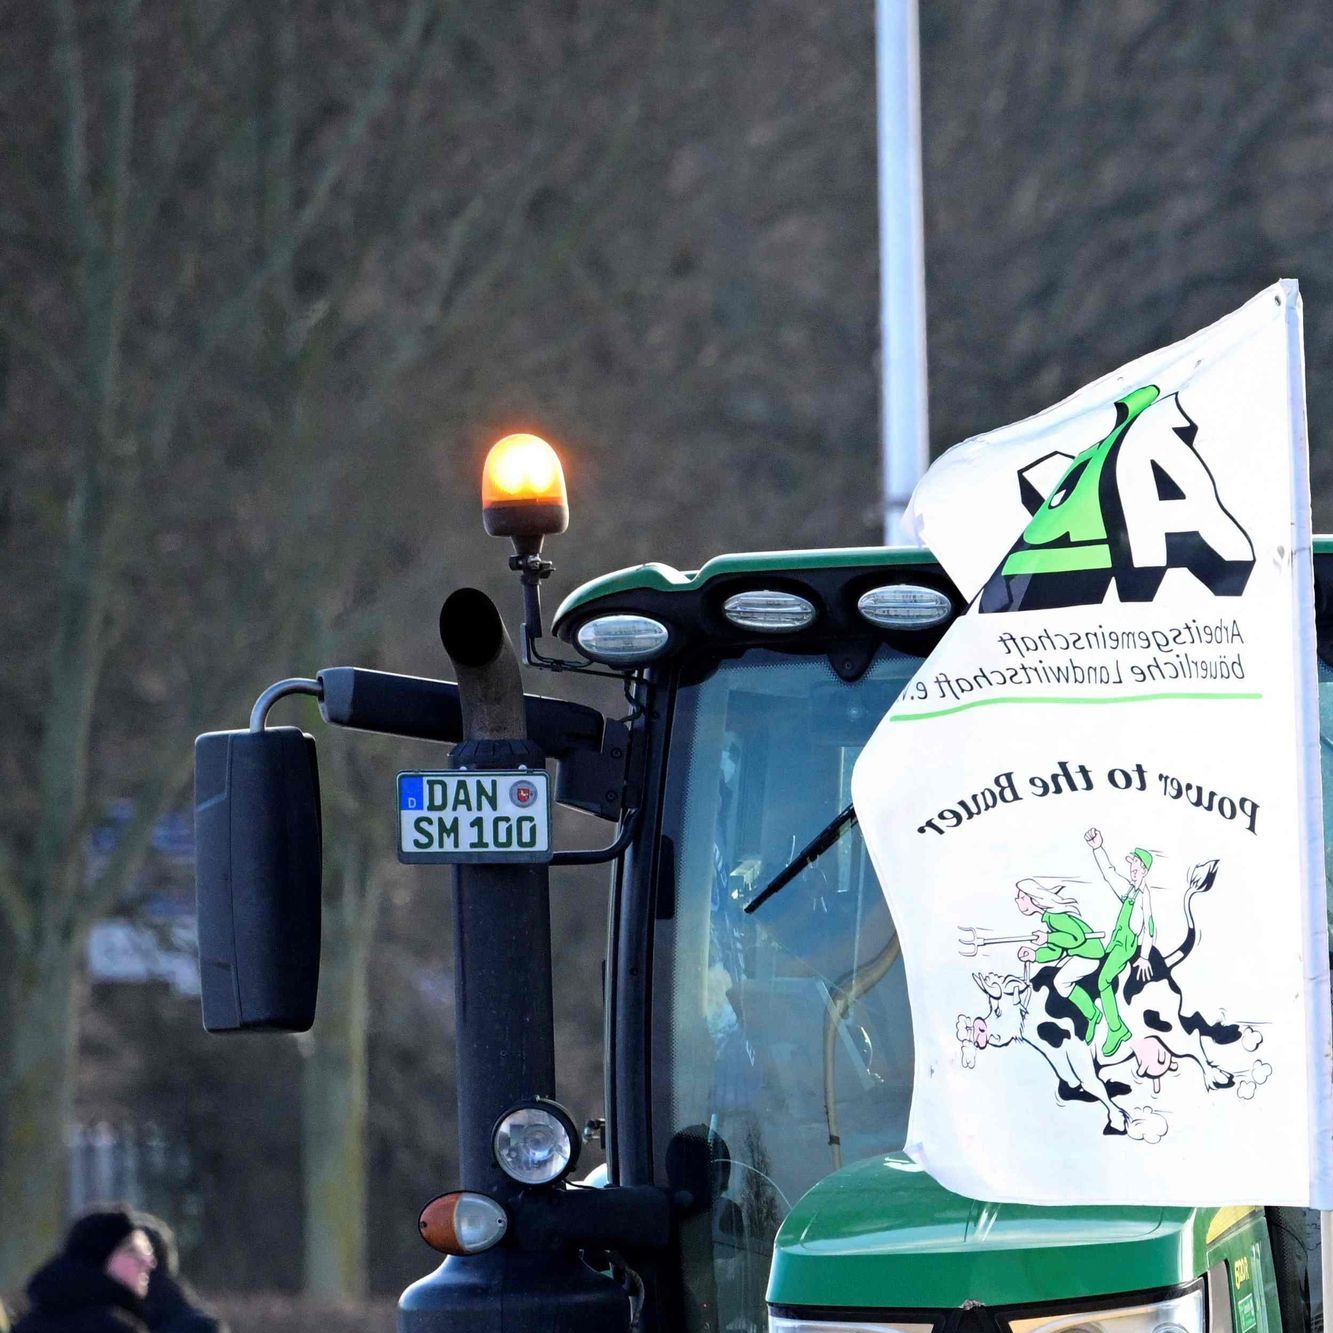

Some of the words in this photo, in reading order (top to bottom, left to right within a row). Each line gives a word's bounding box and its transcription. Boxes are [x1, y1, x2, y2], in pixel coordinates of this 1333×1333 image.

[408, 797, 417, 809] D
[426, 779, 498, 812] DAN
[413, 816, 460, 849] SM
[469, 815, 537, 849] 100
